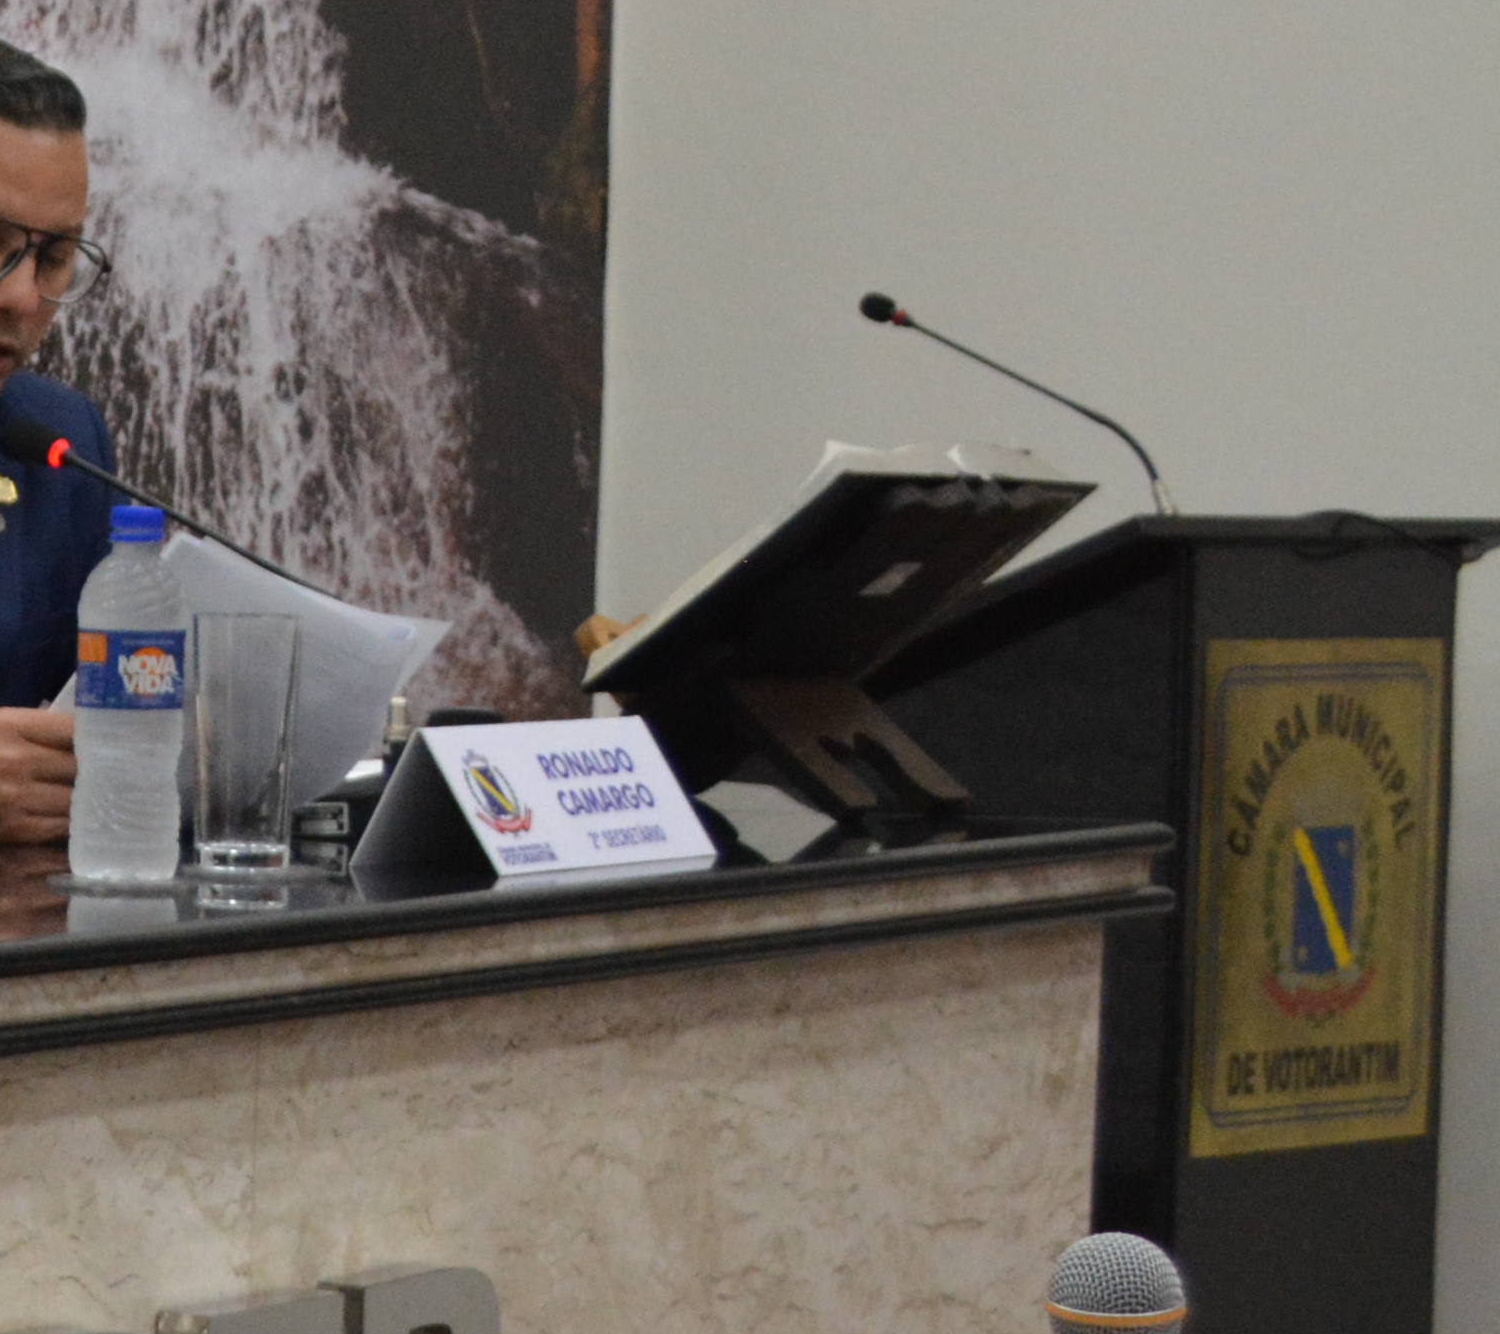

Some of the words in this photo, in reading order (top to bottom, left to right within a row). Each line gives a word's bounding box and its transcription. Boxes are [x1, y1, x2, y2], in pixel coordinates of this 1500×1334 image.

[118, 653, 180, 677] NOVA
[121, 674, 175, 696] VIDA
[536, 746, 635, 781] RONALDO
[1315, 693, 1416, 851] MUNICIPAL
[556, 781, 656, 817] CAMARGO
[1227, 1050, 1257, 1096] DE
[1262, 1040, 1401, 1093] VOTORANTIM
